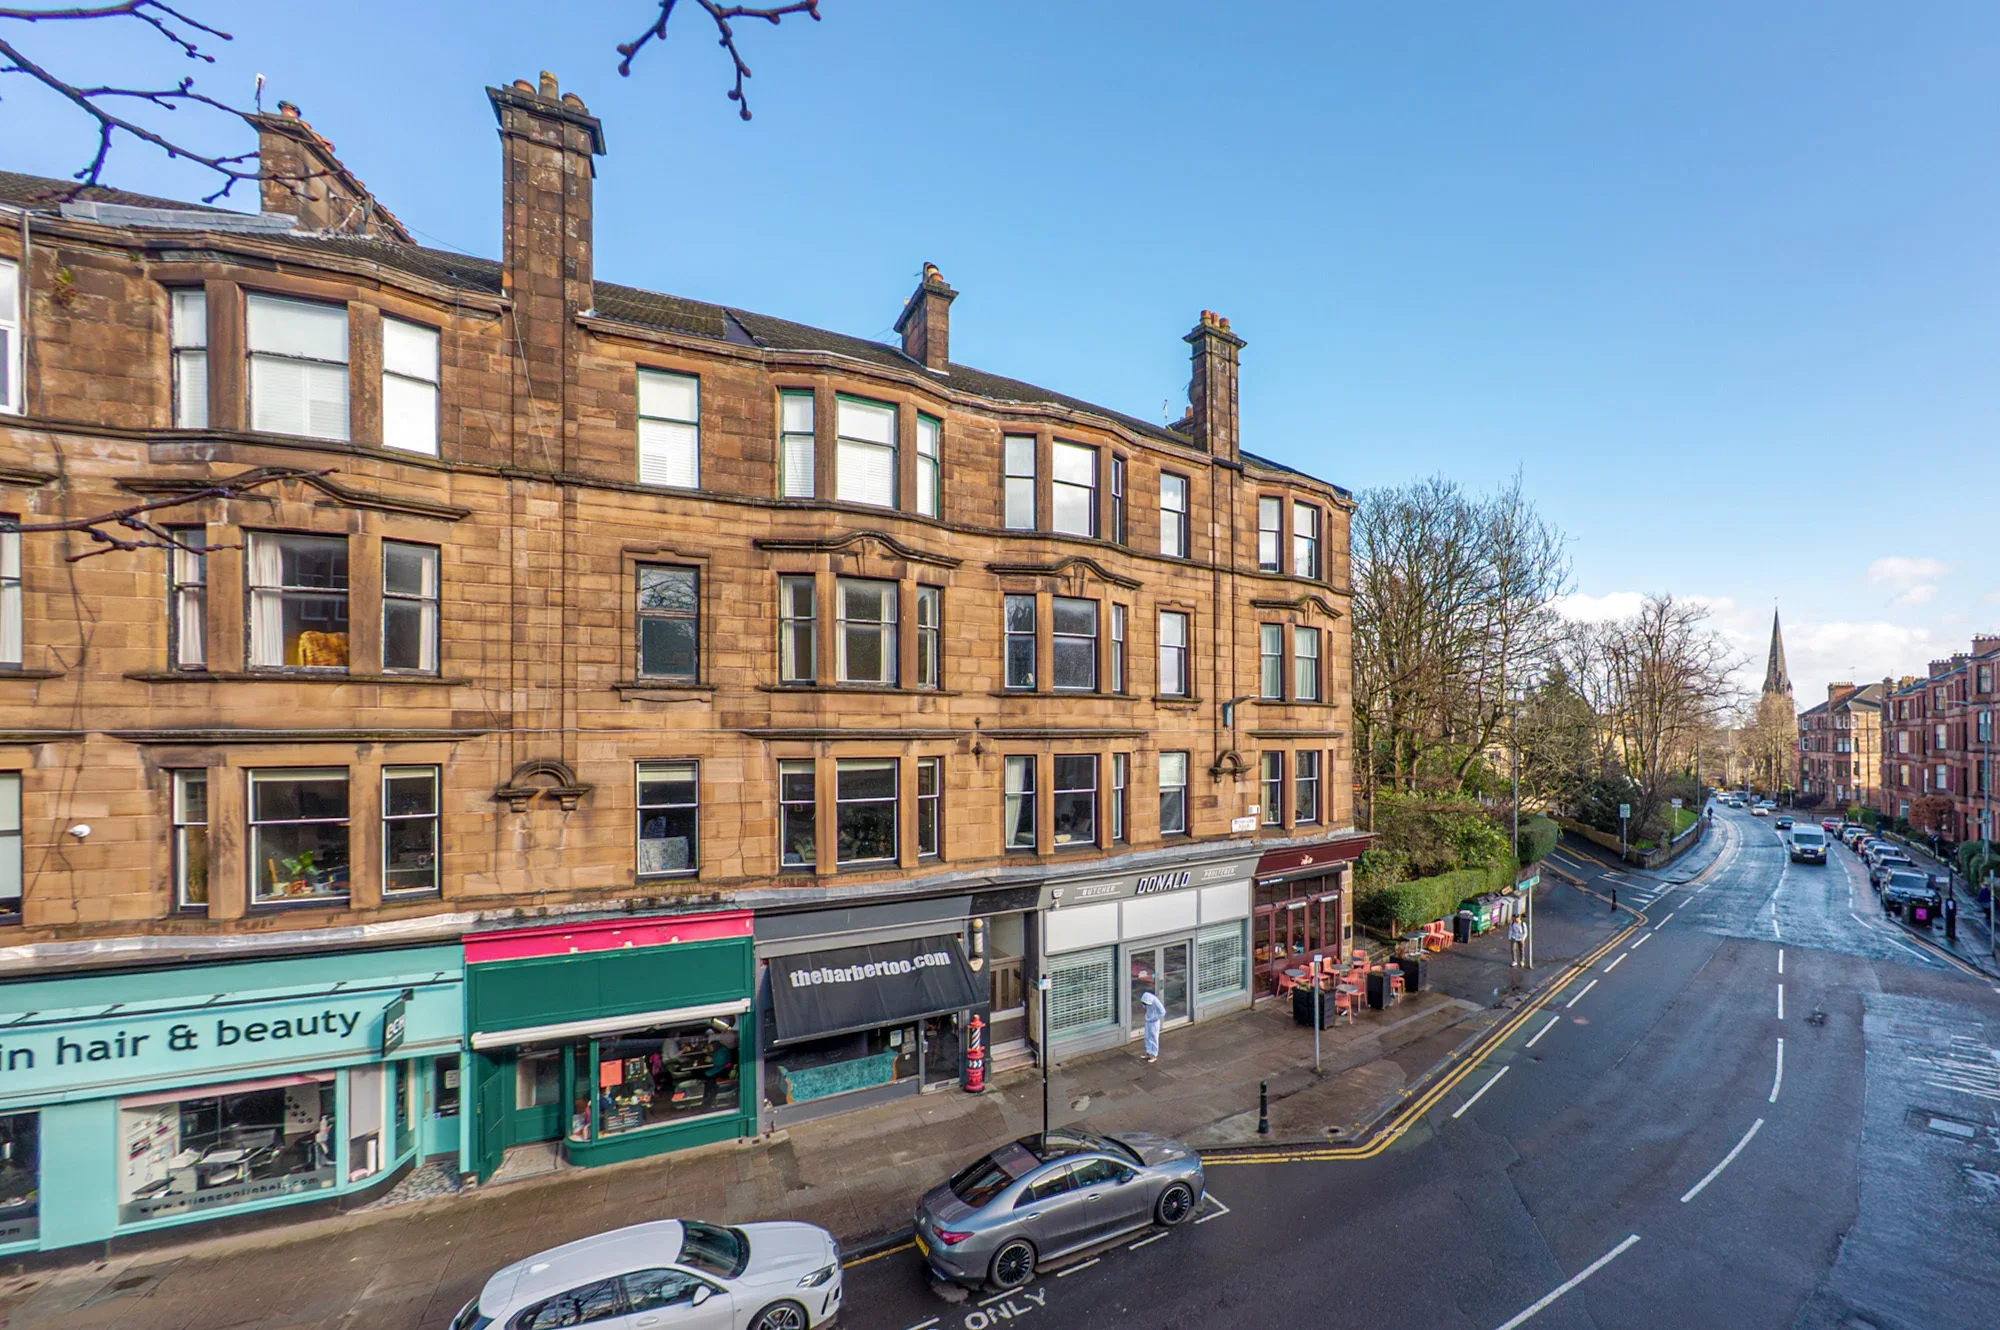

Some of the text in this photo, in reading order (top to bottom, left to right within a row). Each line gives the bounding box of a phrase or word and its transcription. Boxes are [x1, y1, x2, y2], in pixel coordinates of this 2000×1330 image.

[1081, 885, 1116, 897] BUTCHER
[1136, 871, 1191, 895] DONALD
[789, 951, 951, 988] thebarbertoo.com
[0, 1009, 361, 1072] n hair & beauty
[964, 1287, 1046, 1330] ONLY
